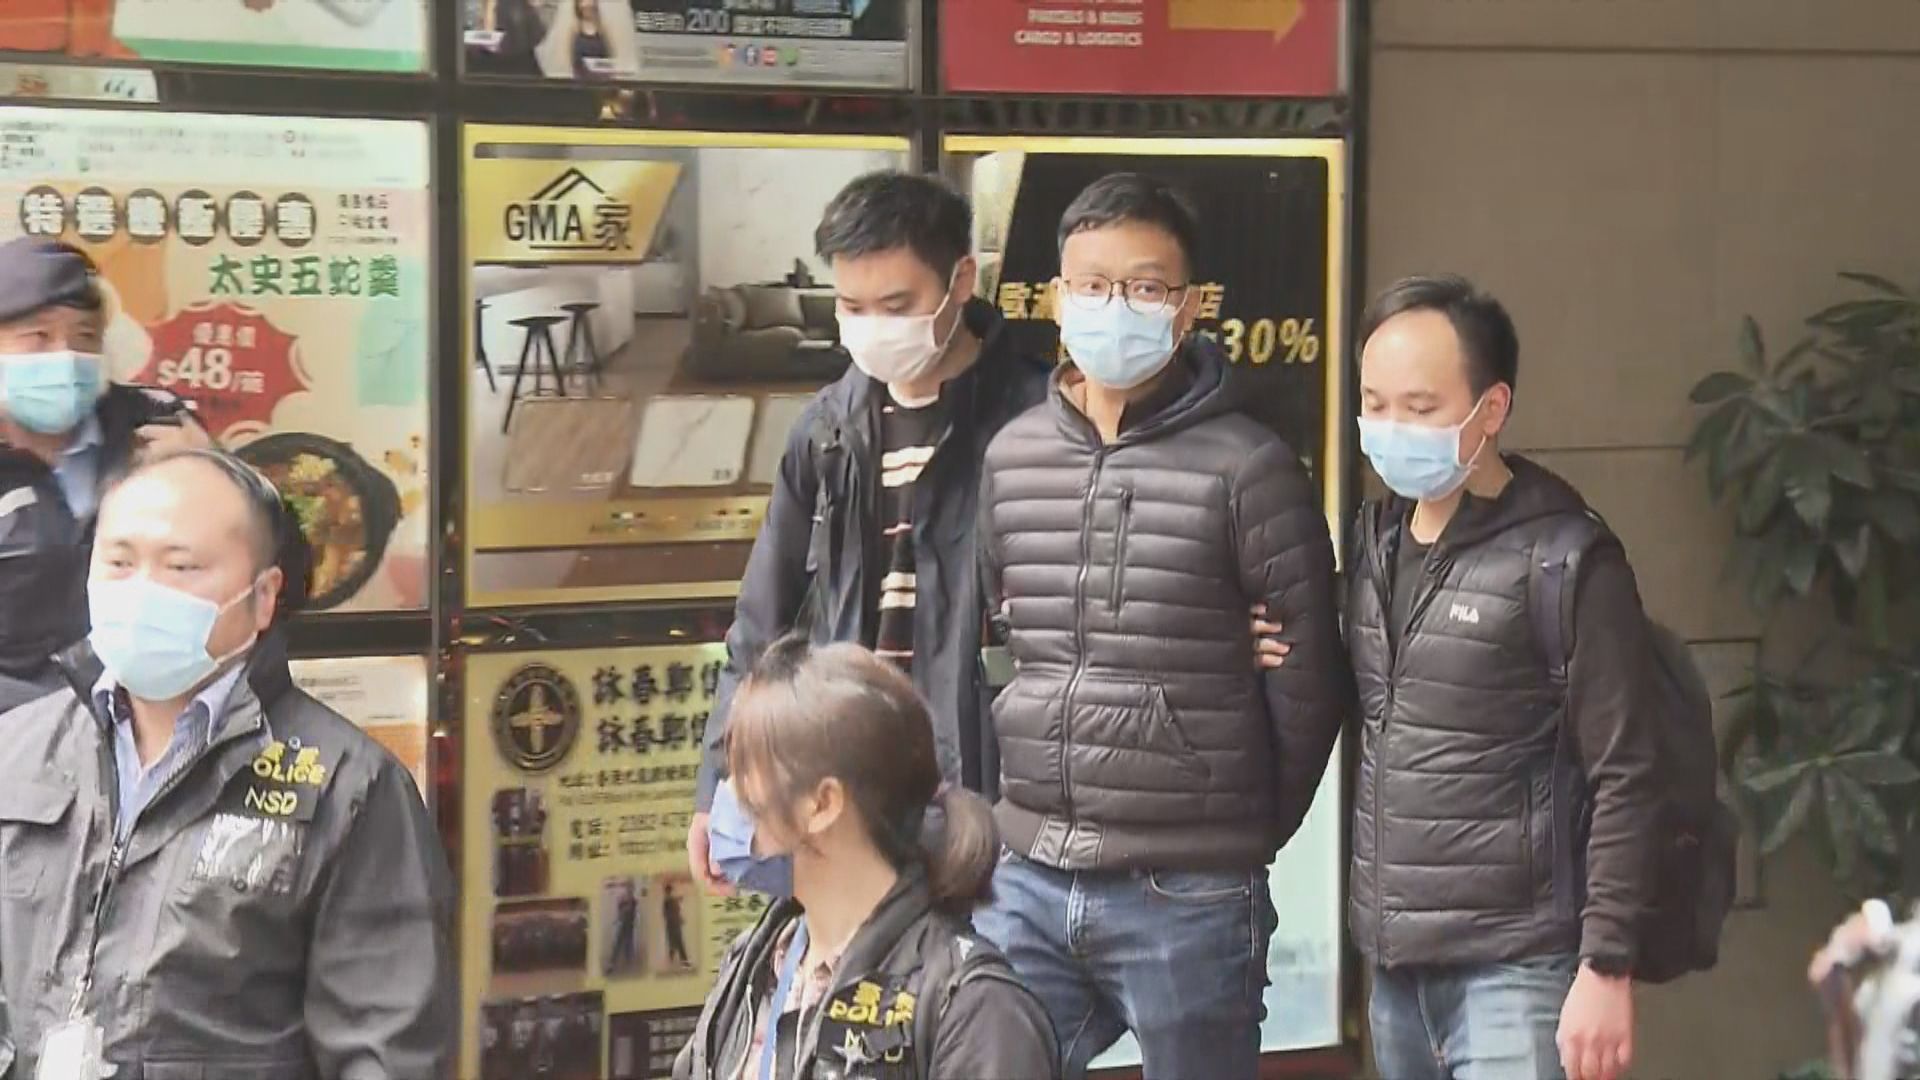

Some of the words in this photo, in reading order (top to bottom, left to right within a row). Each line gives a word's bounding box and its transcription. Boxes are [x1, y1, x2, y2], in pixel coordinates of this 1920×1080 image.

[505, 203, 584, 241] GMA
[209, 253, 398, 297] 太史五蛇羹
[1221, 317, 1319, 365] 30%
[244, 786, 298, 815] NSD
